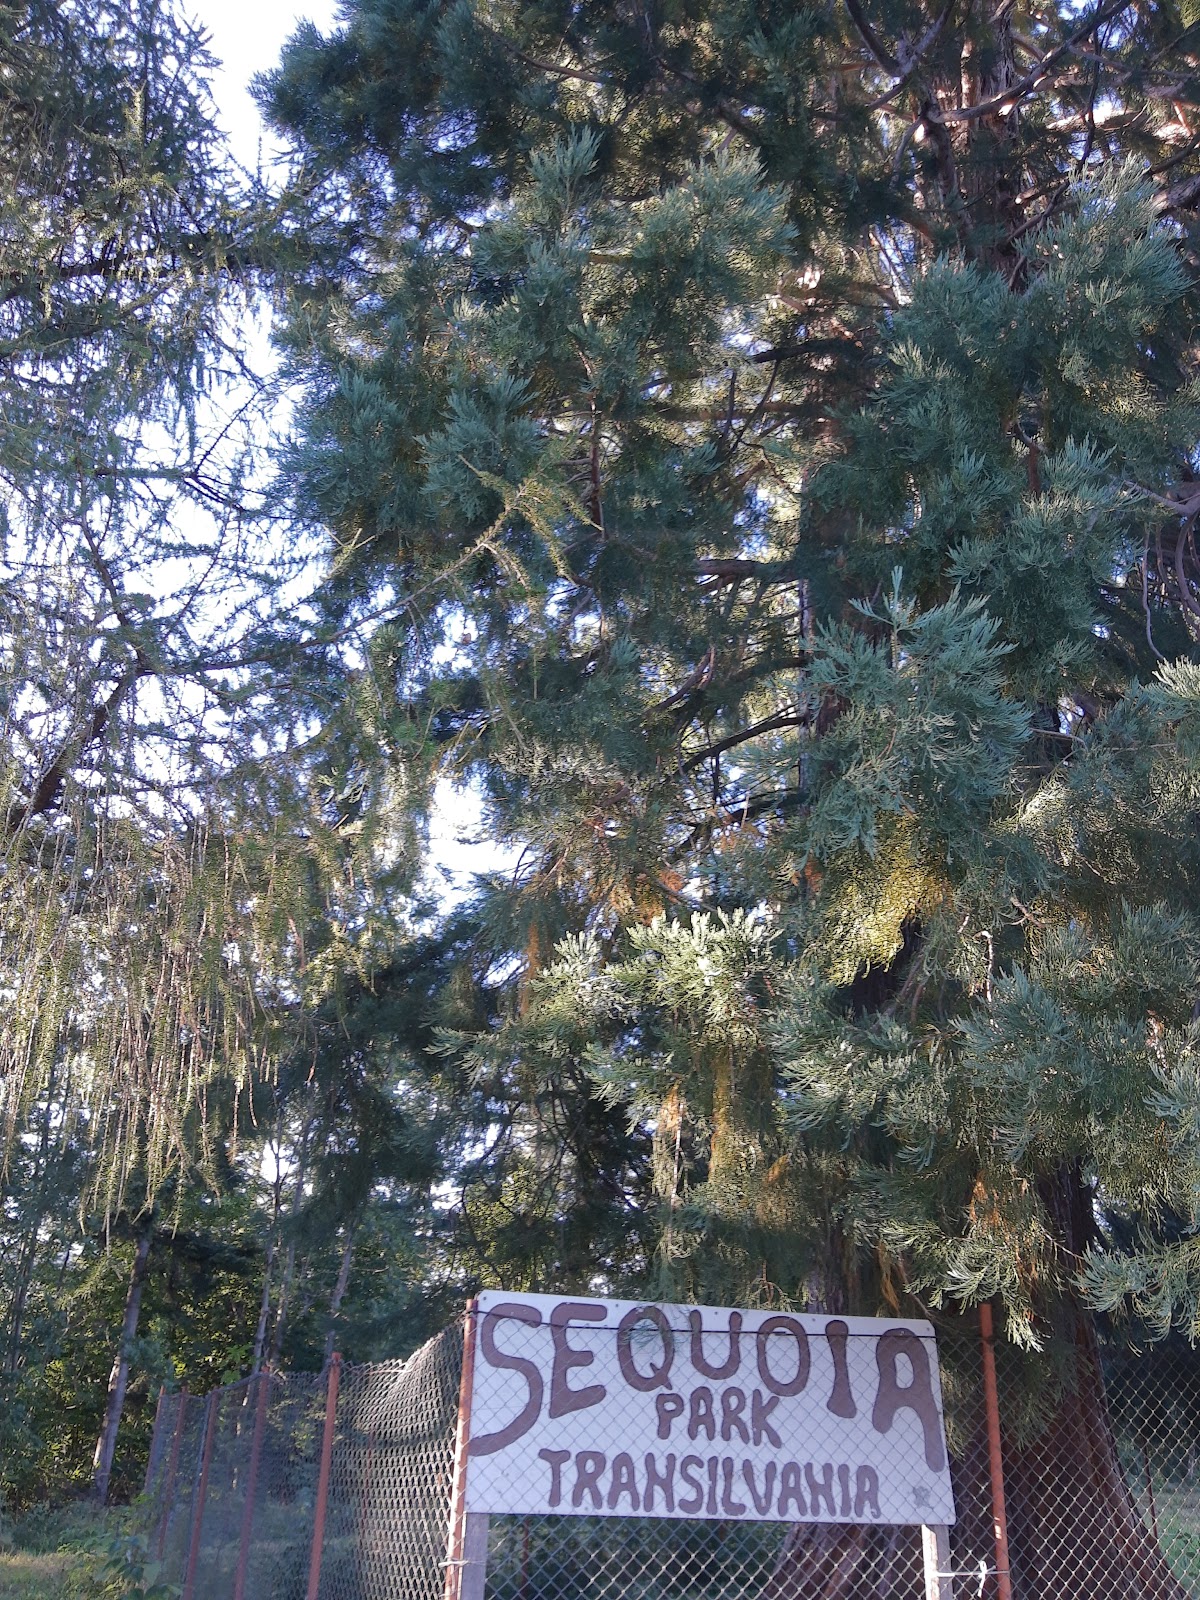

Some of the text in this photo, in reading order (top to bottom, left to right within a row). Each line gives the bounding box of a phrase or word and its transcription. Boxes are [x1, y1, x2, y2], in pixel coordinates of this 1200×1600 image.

[469, 1303, 945, 1472] SEQUOIA
[656, 1387, 782, 1449] PARK
[538, 1448, 881, 1518] TRANSILVANIA
